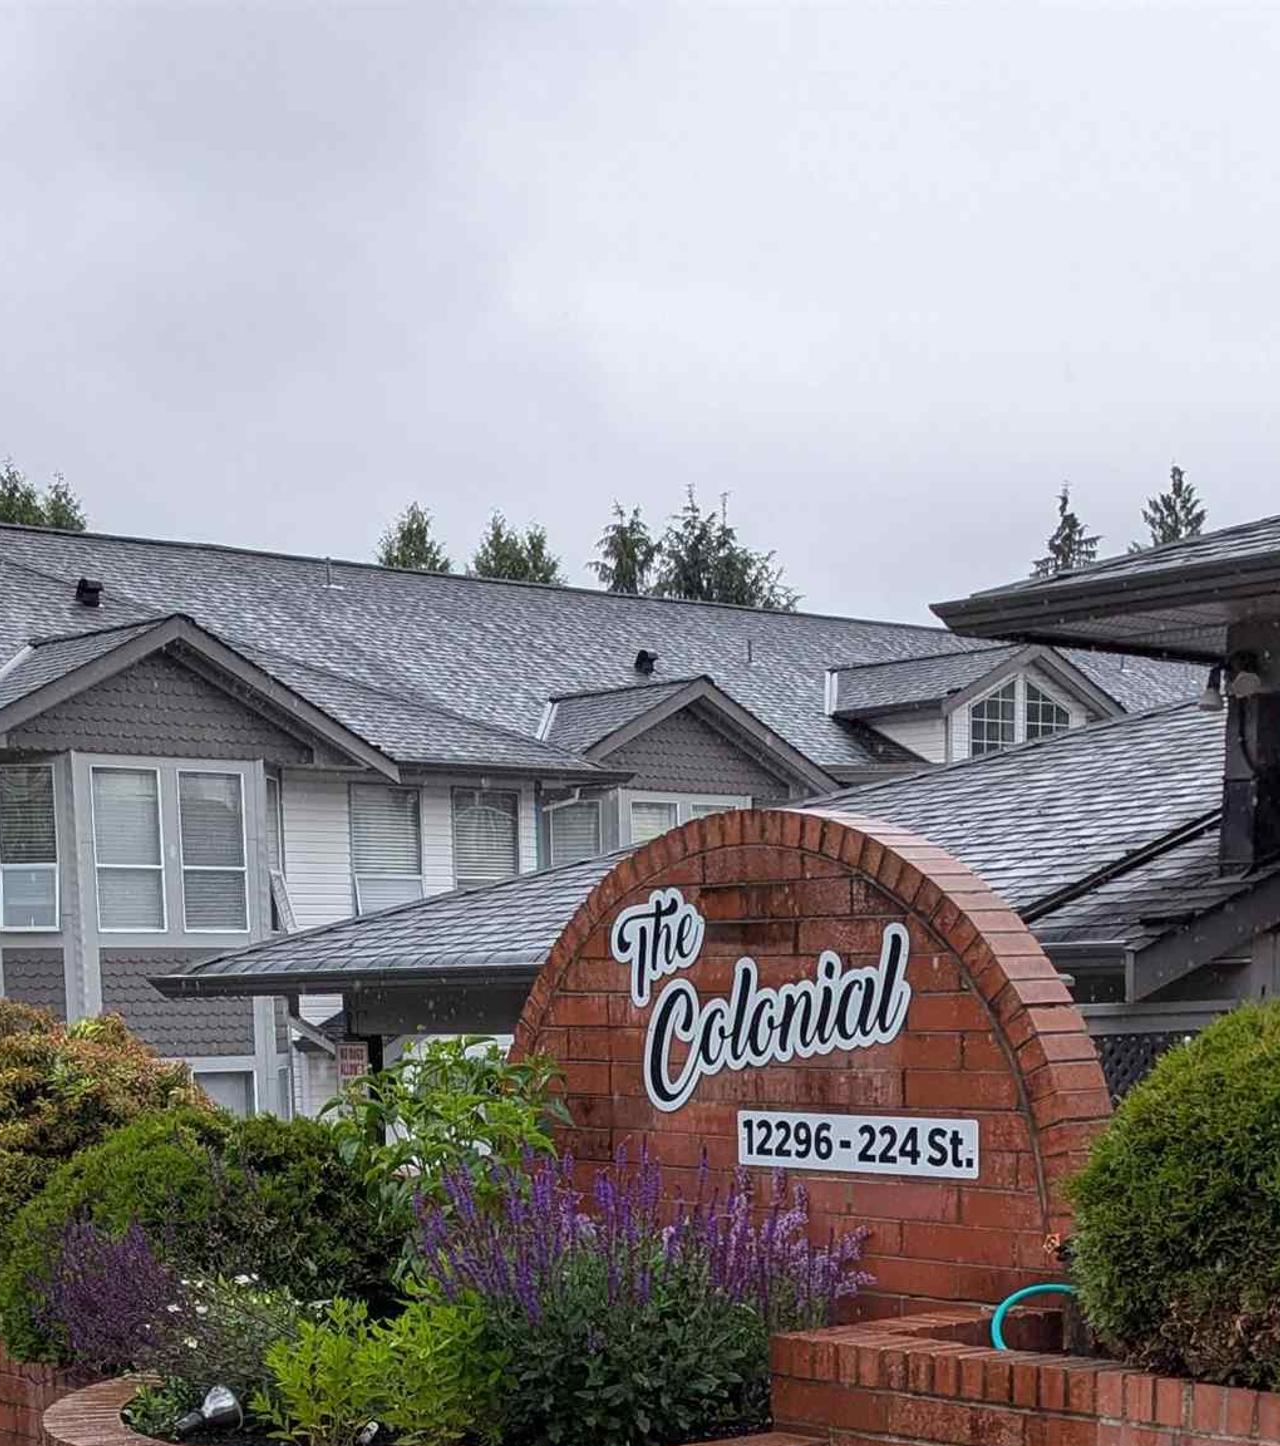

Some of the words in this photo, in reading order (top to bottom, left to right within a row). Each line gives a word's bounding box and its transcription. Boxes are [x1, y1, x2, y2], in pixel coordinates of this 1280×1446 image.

[616, 895, 700, 1000] The
[648, 931, 906, 1103] Colonial
[741, 1118, 834, 1161] 12296
[857, 1123, 922, 1166] 224
[926, 1127, 975, 1169] St.
